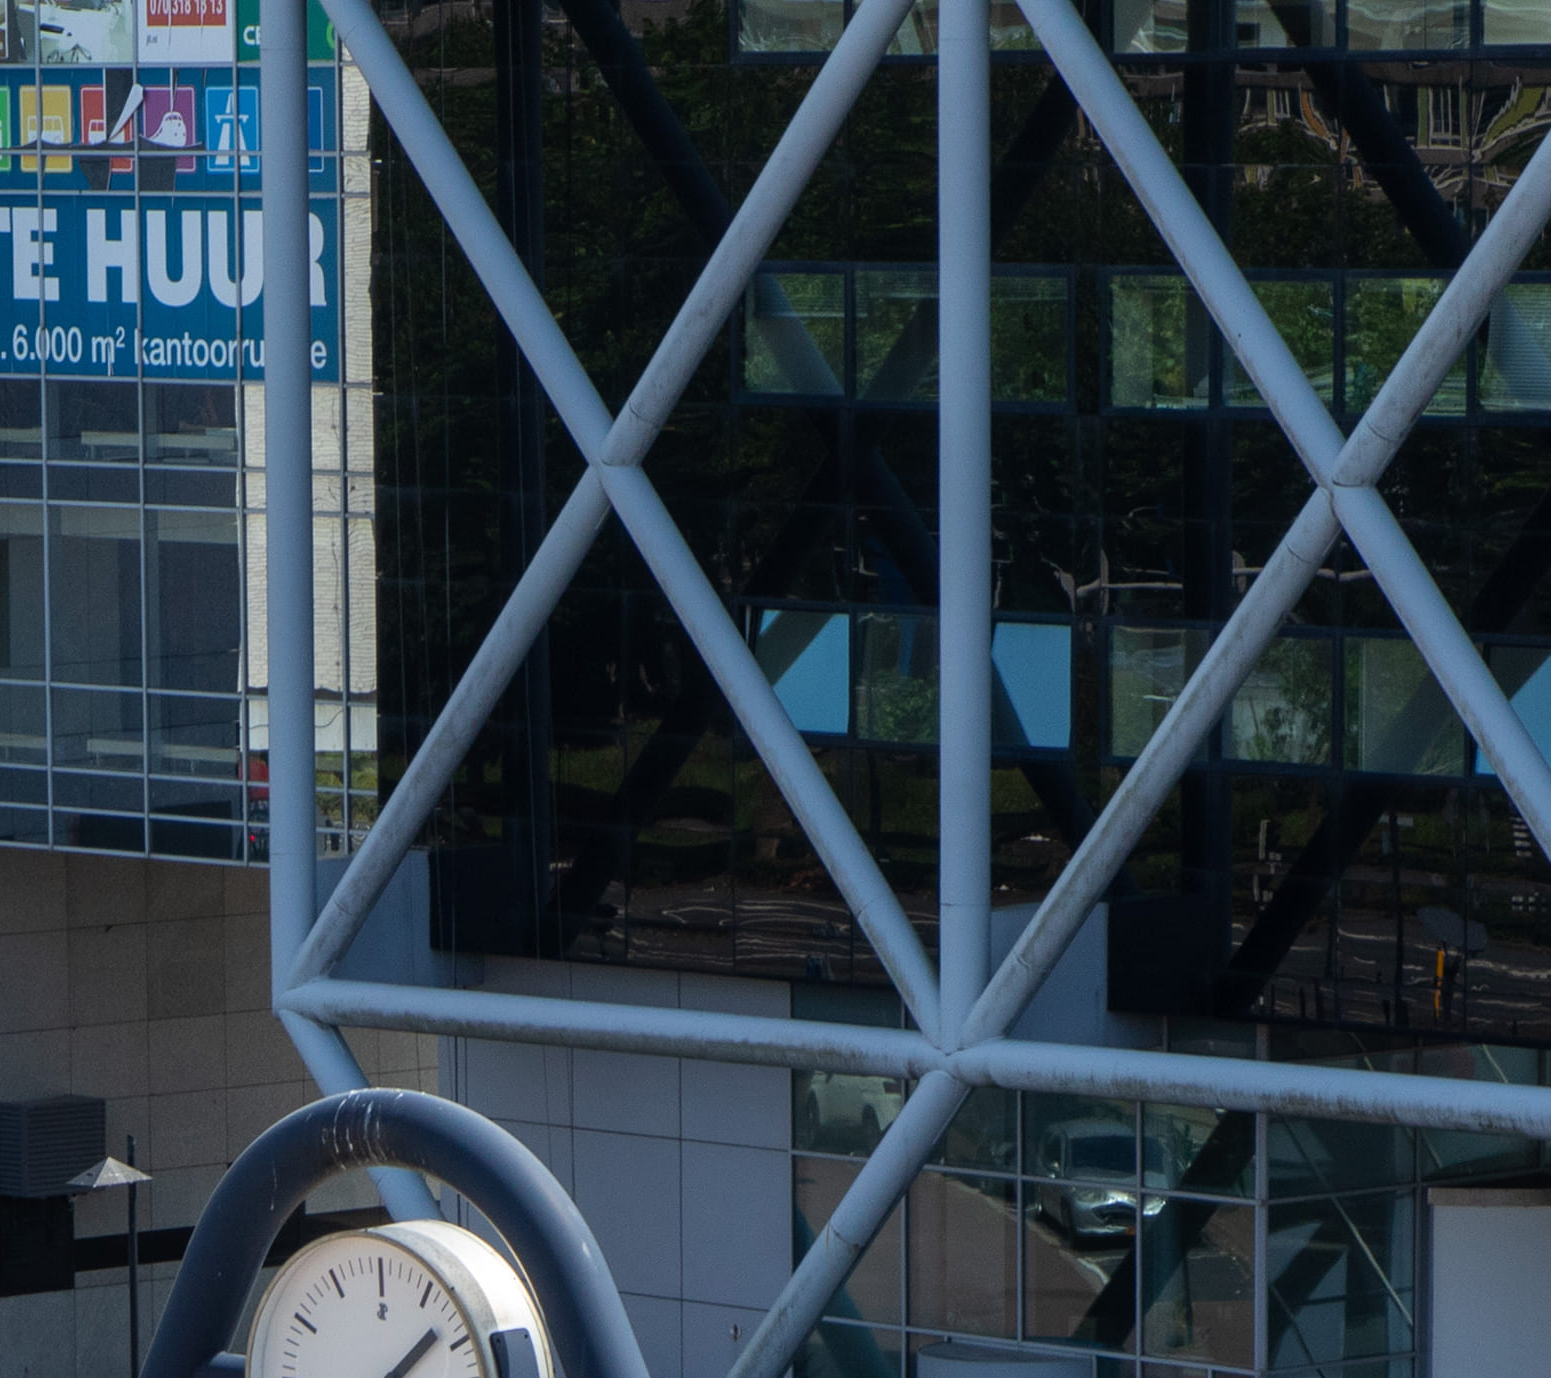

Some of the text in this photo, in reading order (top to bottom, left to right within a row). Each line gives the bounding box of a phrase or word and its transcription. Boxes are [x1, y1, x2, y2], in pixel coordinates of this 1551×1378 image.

[12, 324, 83, 363] 6.000
[92, 326, 125, 365] m²
[135, 329, 327, 370] kantoorrue
